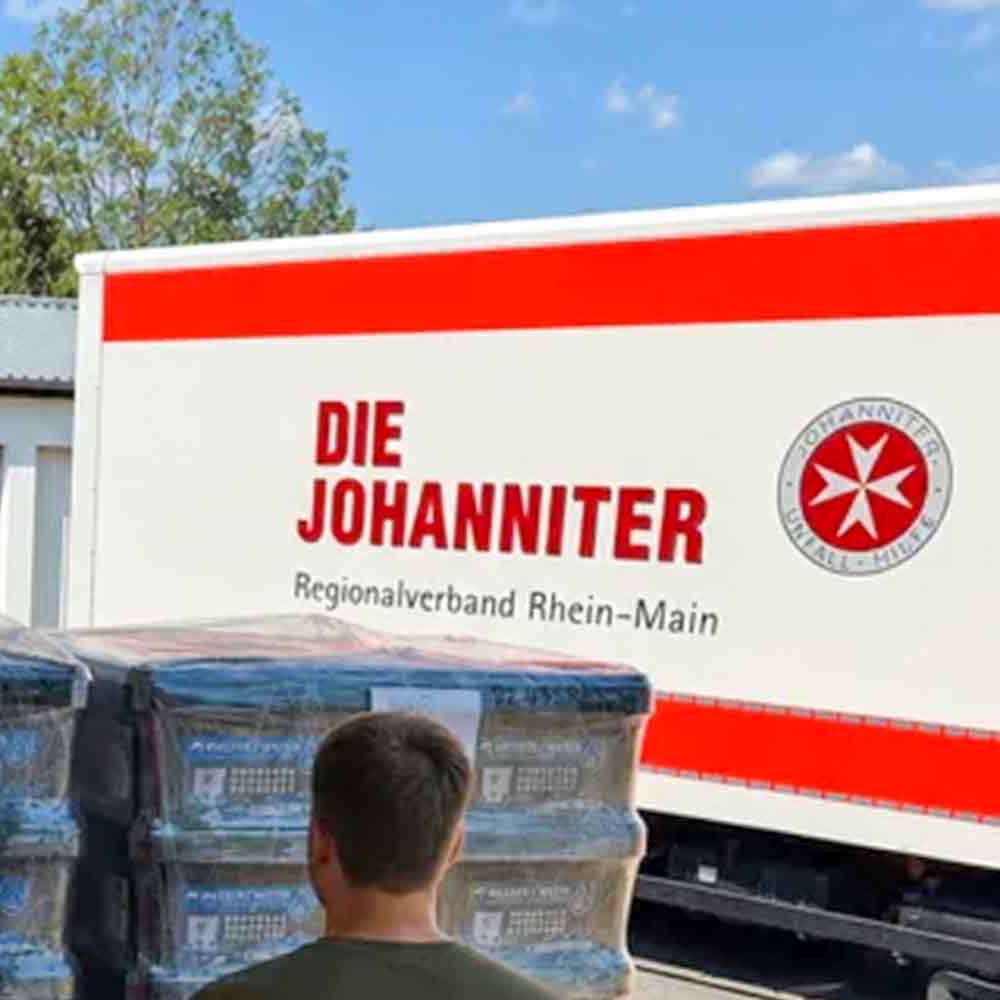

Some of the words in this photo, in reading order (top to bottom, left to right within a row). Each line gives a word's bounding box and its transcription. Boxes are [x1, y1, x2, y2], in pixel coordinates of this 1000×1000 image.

[315, 400, 405, 467] DIE
[798, 404, 940, 459] JOHANNITER
[297, 477, 708, 565] JOHANNITER
[293, 571, 516, 619] Regionalverband
[528, 590, 719, 636] Rhein-Main
